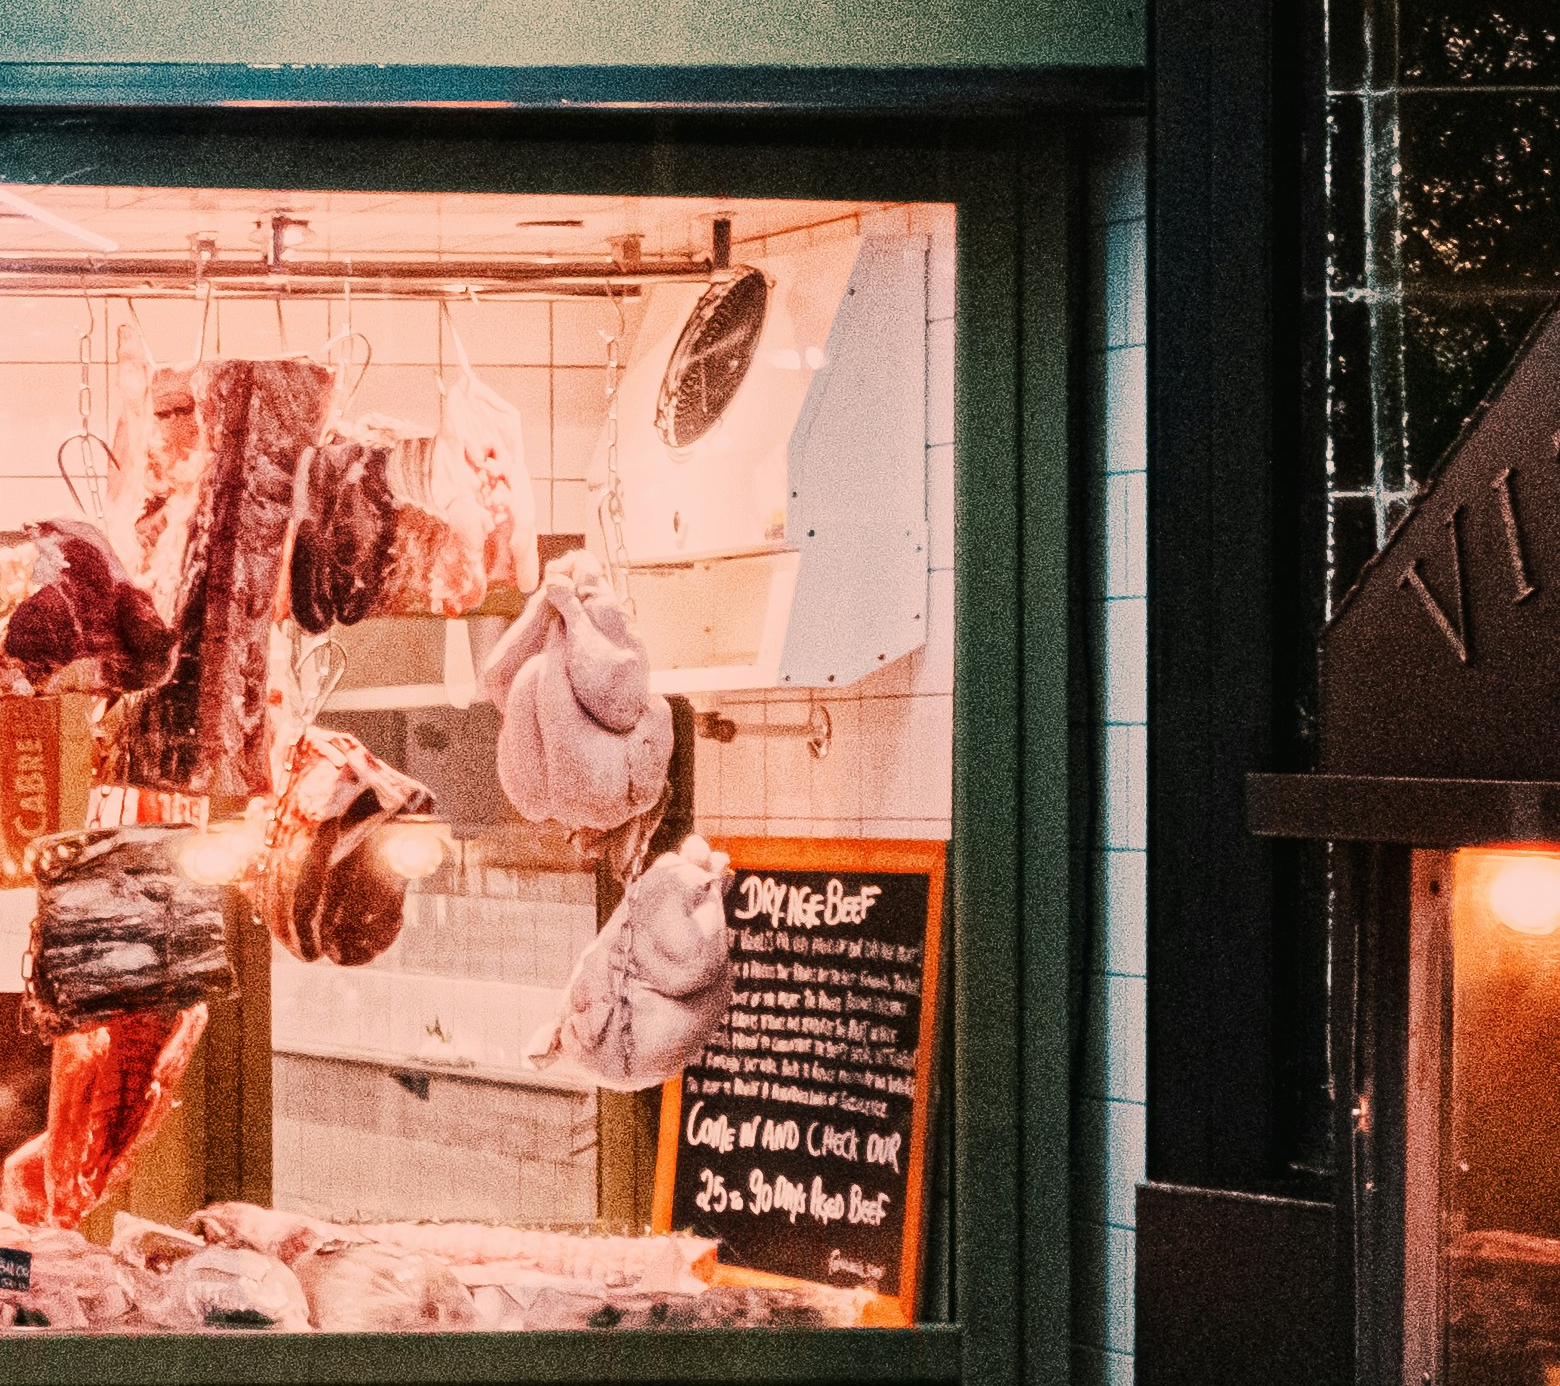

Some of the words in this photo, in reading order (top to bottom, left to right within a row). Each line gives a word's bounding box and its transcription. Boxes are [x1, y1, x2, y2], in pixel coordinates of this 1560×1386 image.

[762, 1120, 800, 1152] AND
[866, 1132, 902, 1174] OUR
[696, 1168, 727, 1213] 25
